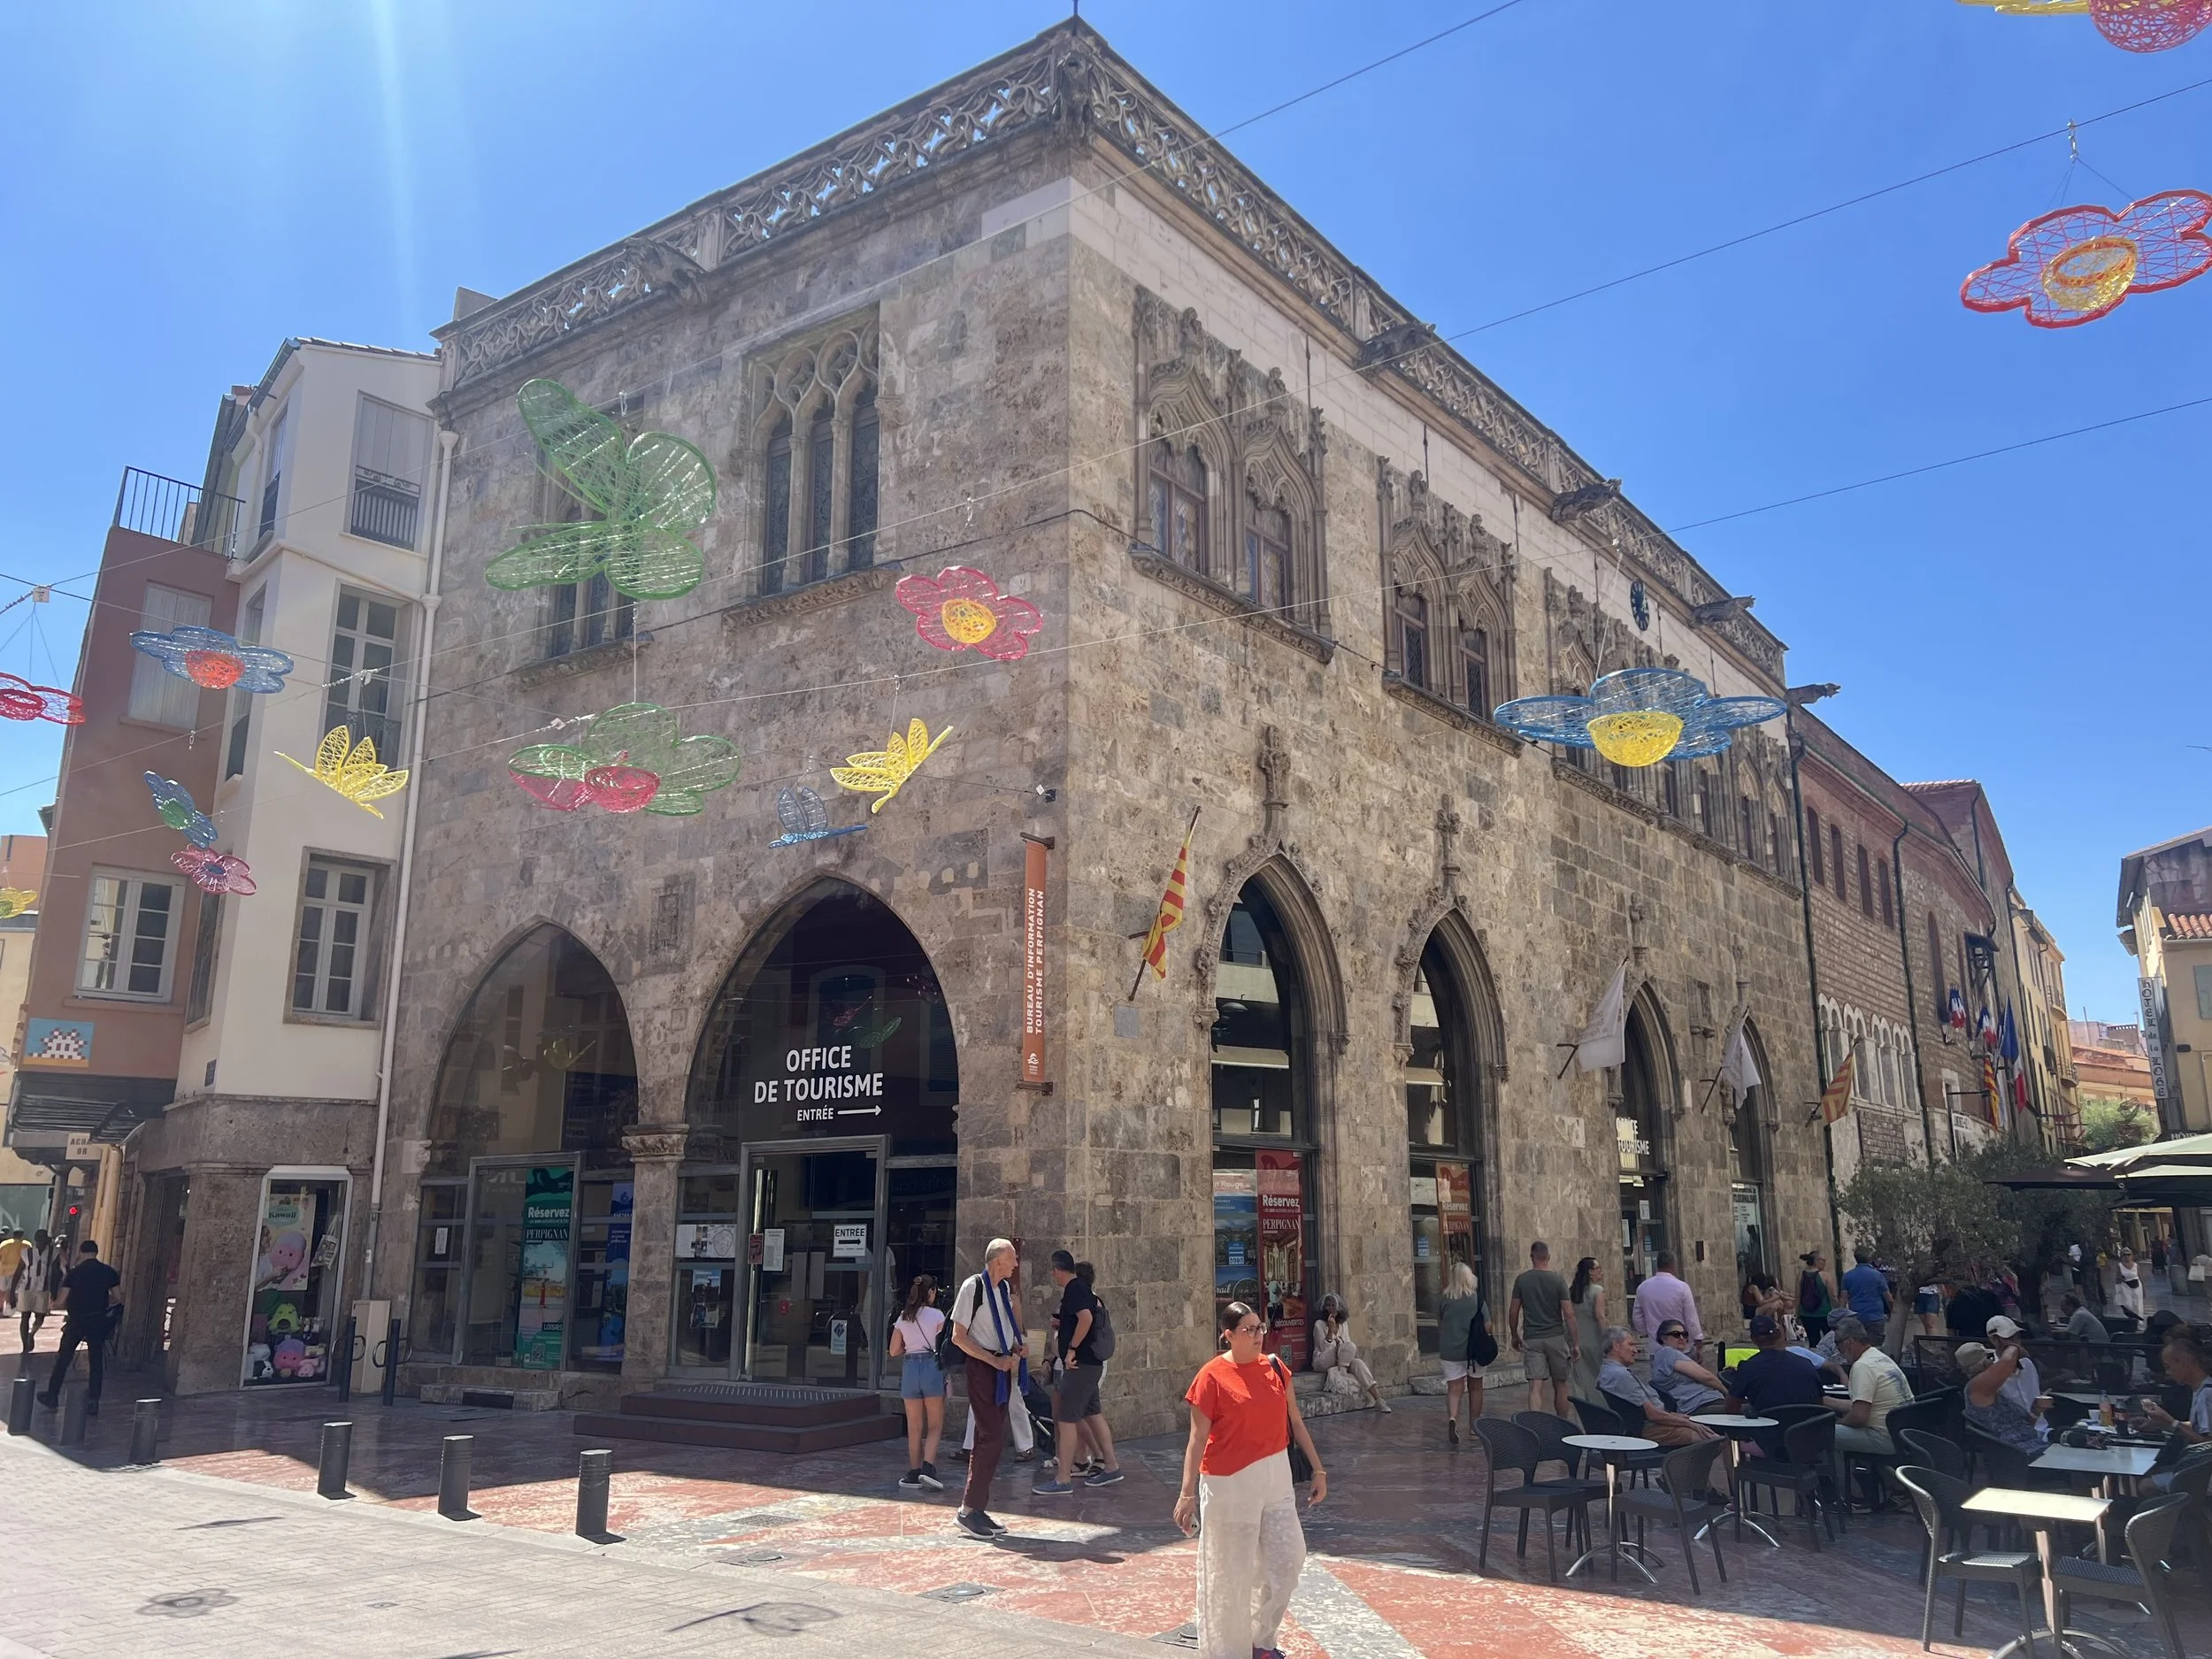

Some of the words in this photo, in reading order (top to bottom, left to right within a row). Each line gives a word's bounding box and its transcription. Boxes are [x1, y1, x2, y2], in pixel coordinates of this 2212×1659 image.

[786, 1045, 852, 1072] OFFICE
[754, 1080, 779, 1103] DE
[784, 1072, 884, 1102] TOURISME
[796, 1105, 834, 1122] ENTRÉE
[1263, 1194, 1300, 1207] Réservez
[528, 1206, 570, 1218] Réservez
[1263, 1218, 1300, 1230] PERPIGNAN
[526, 1227, 569, 1240] PERPIGNAN
[834, 1226, 865, 1237] ENTRÉE
[543, 1323, 563, 1332] LOISIRS
[1274, 1317, 1305, 1327] DÉCOUVERTES
